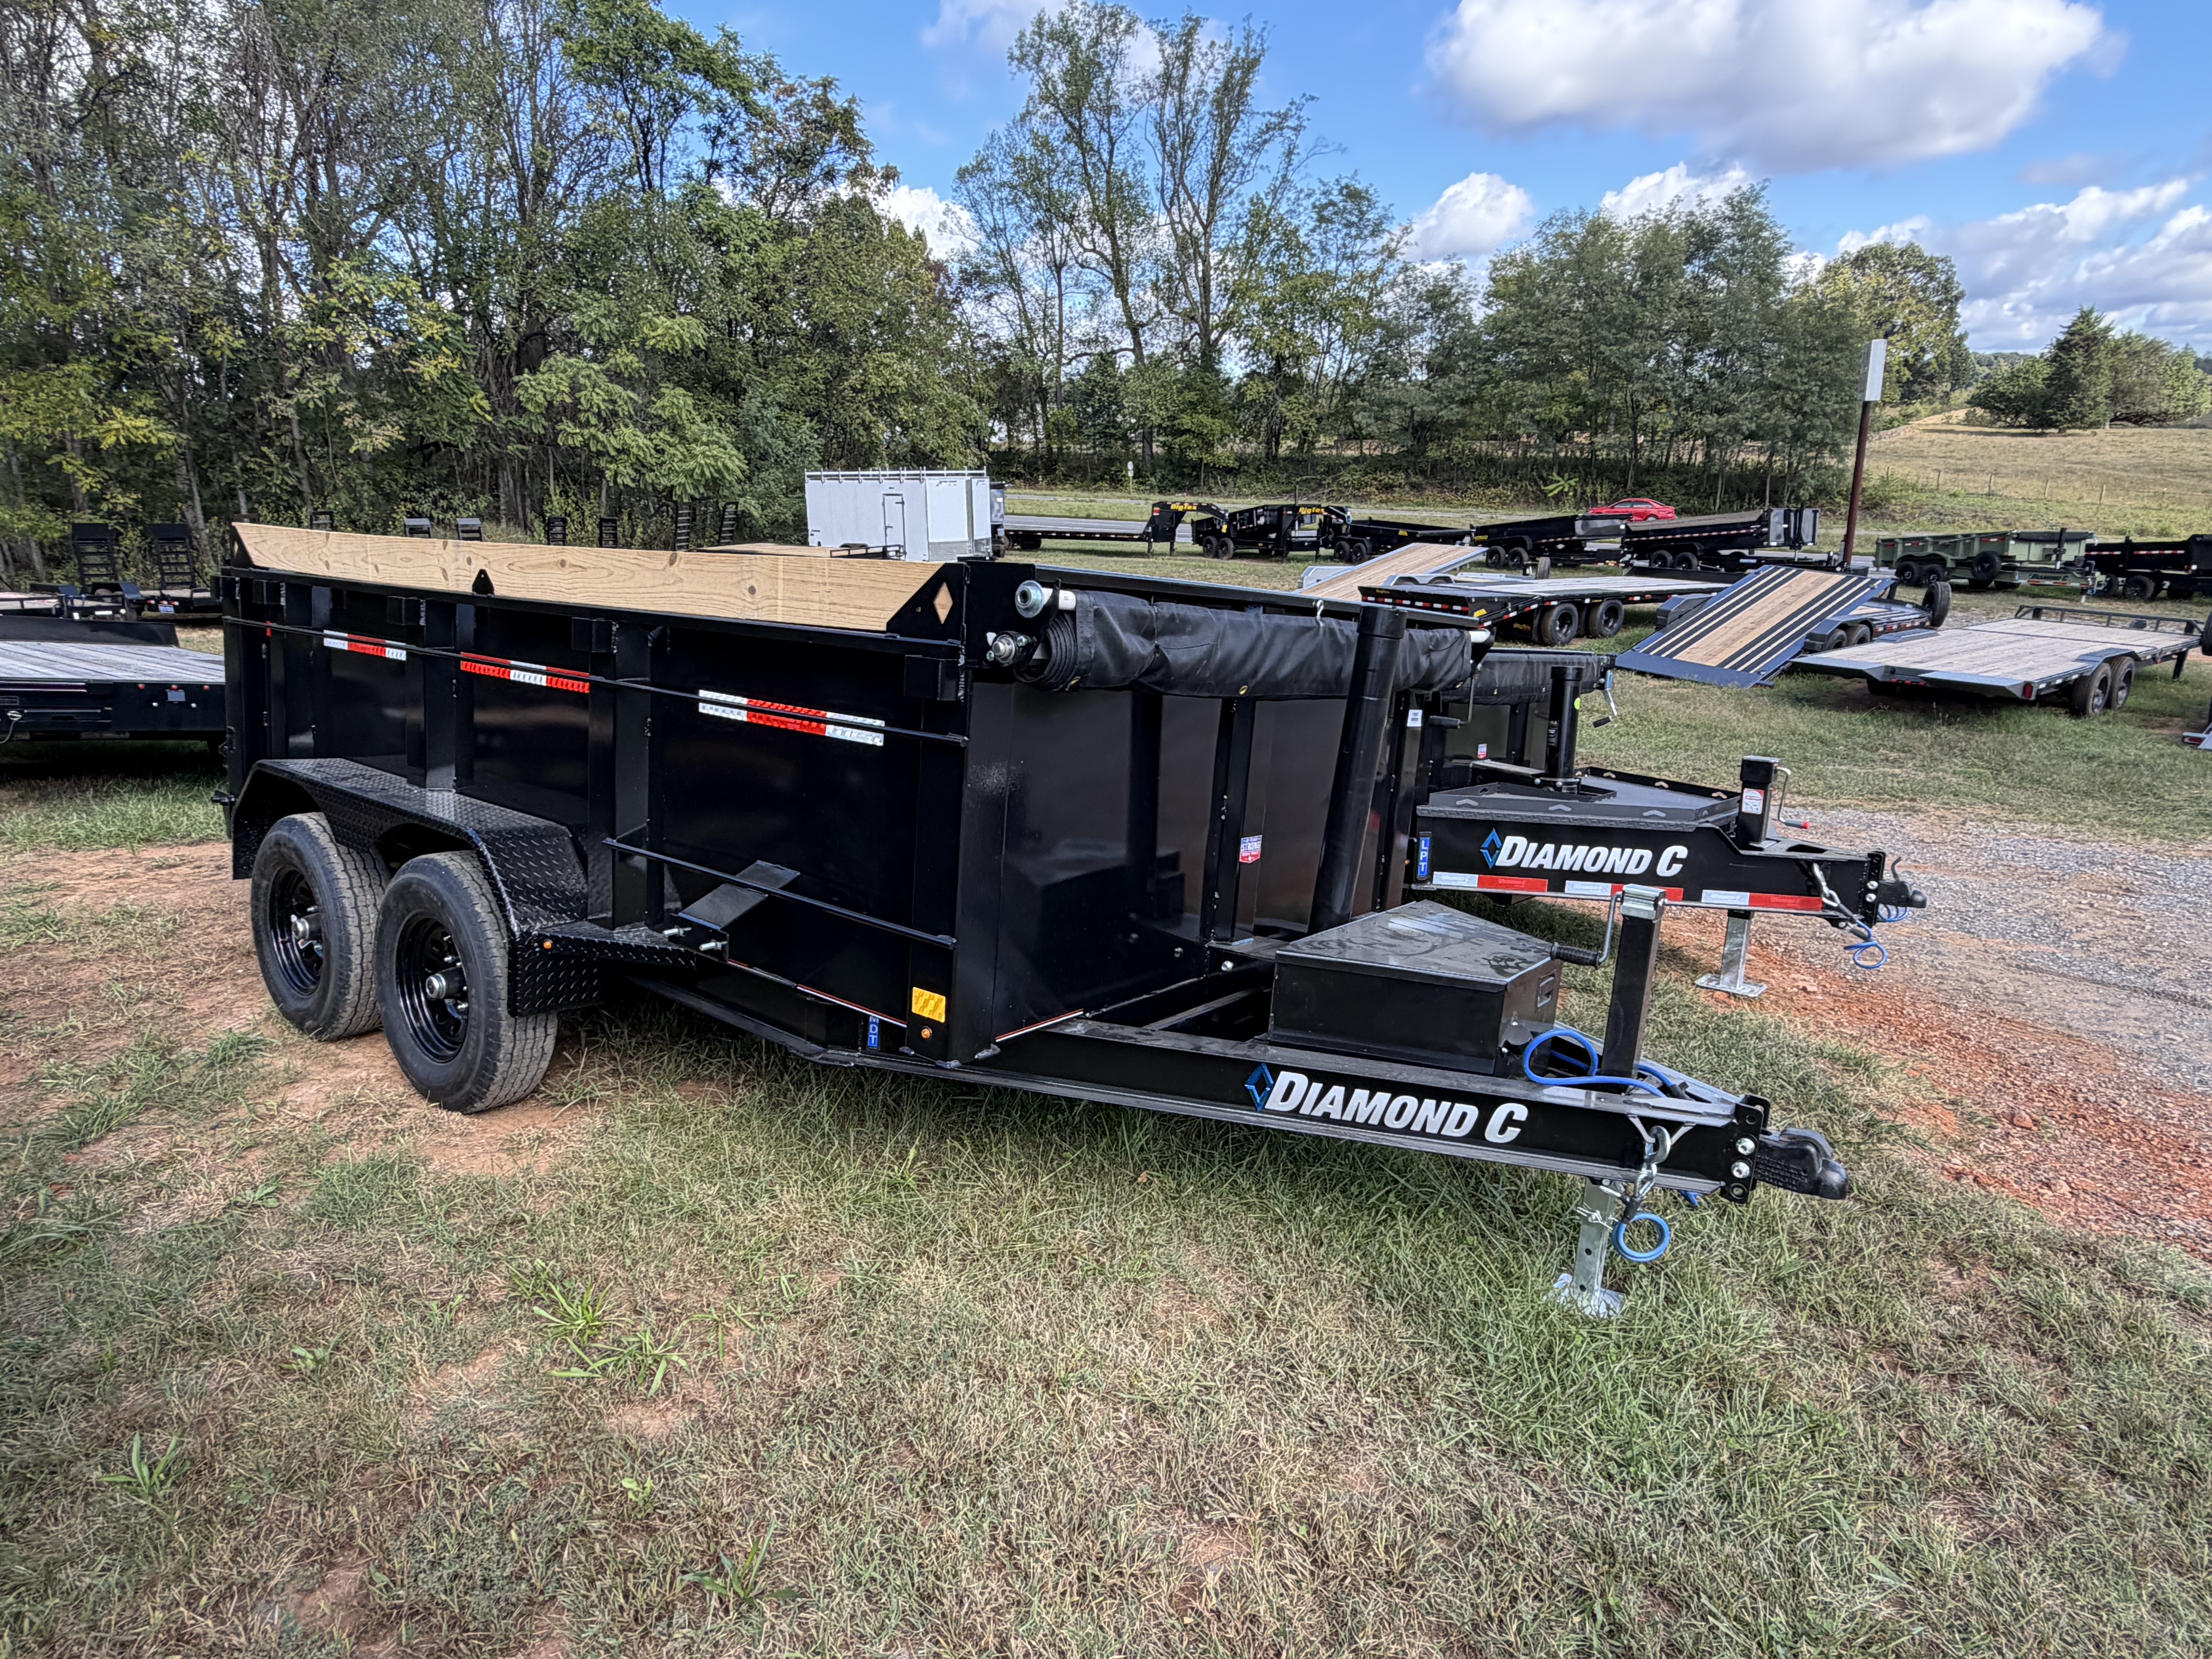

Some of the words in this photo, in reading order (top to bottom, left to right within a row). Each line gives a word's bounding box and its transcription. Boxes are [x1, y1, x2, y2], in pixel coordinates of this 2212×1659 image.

[1419, 840, 1428, 872] LPT
[1495, 836, 1653, 874] DIAMOND
[1656, 845, 1688, 877] C
[1264, 1071, 1479, 1137] DIAMOND
[1484, 1103, 1528, 1144] C
